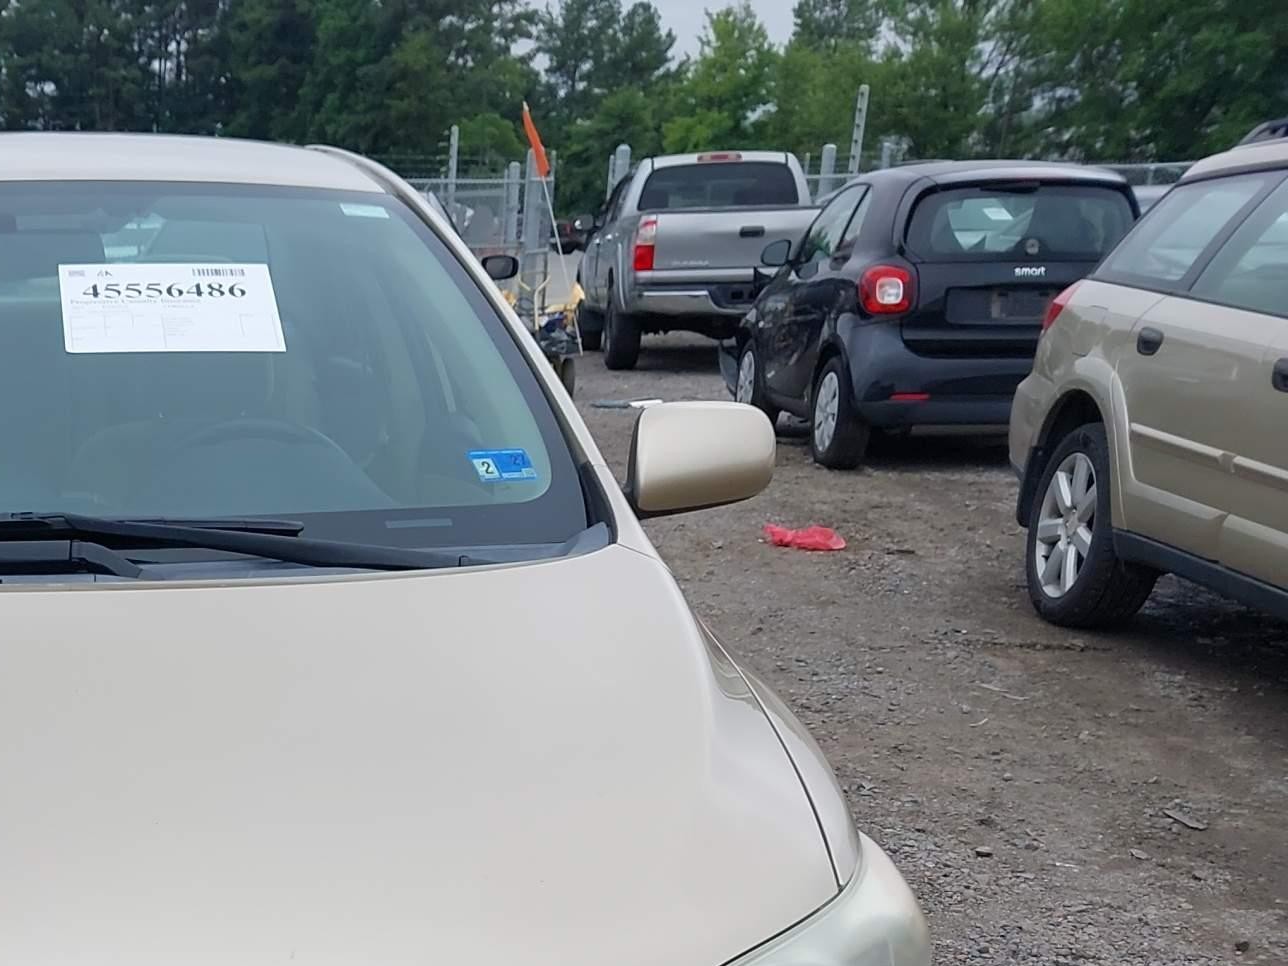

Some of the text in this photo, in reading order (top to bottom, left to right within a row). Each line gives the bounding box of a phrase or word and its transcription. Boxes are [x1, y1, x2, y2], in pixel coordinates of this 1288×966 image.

[1014, 266, 1046, 277] smart
[82, 282, 246, 299] 45556486
[481, 461, 494, 474] 2
